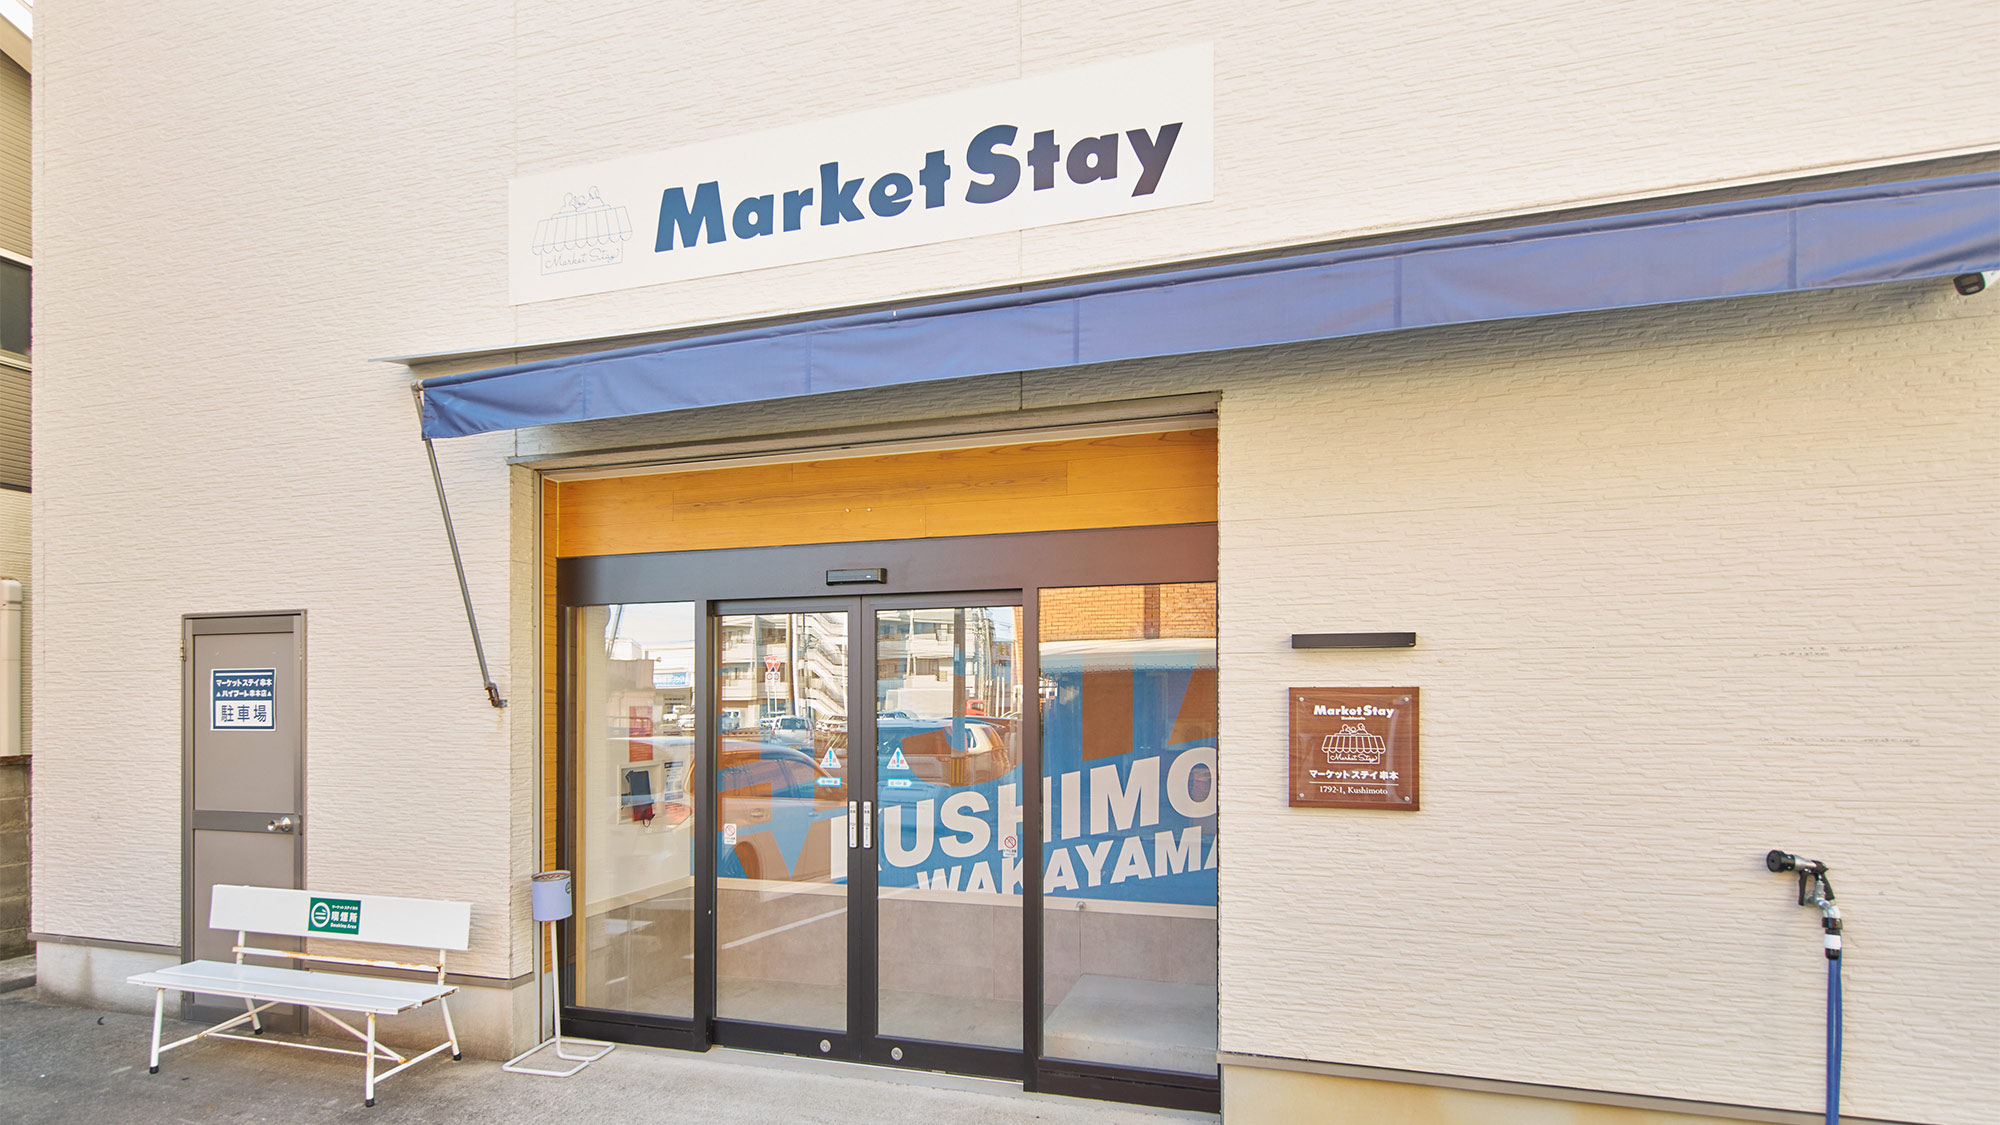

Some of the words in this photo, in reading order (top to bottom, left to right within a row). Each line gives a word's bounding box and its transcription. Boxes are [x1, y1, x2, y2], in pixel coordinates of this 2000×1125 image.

[545, 251, 586, 269] Market
[589, 248, 620, 263] Stay
[221, 704, 267, 723] 駐車場
[1330, 753, 1358, 761] Market
[1358, 753, 1378, 763] Stay
[1319, 786, 1346, 795] 1792-1,
[1347, 786, 1389, 795] Kushimoto
[917, 825, 1216, 896] WAKAYAM
